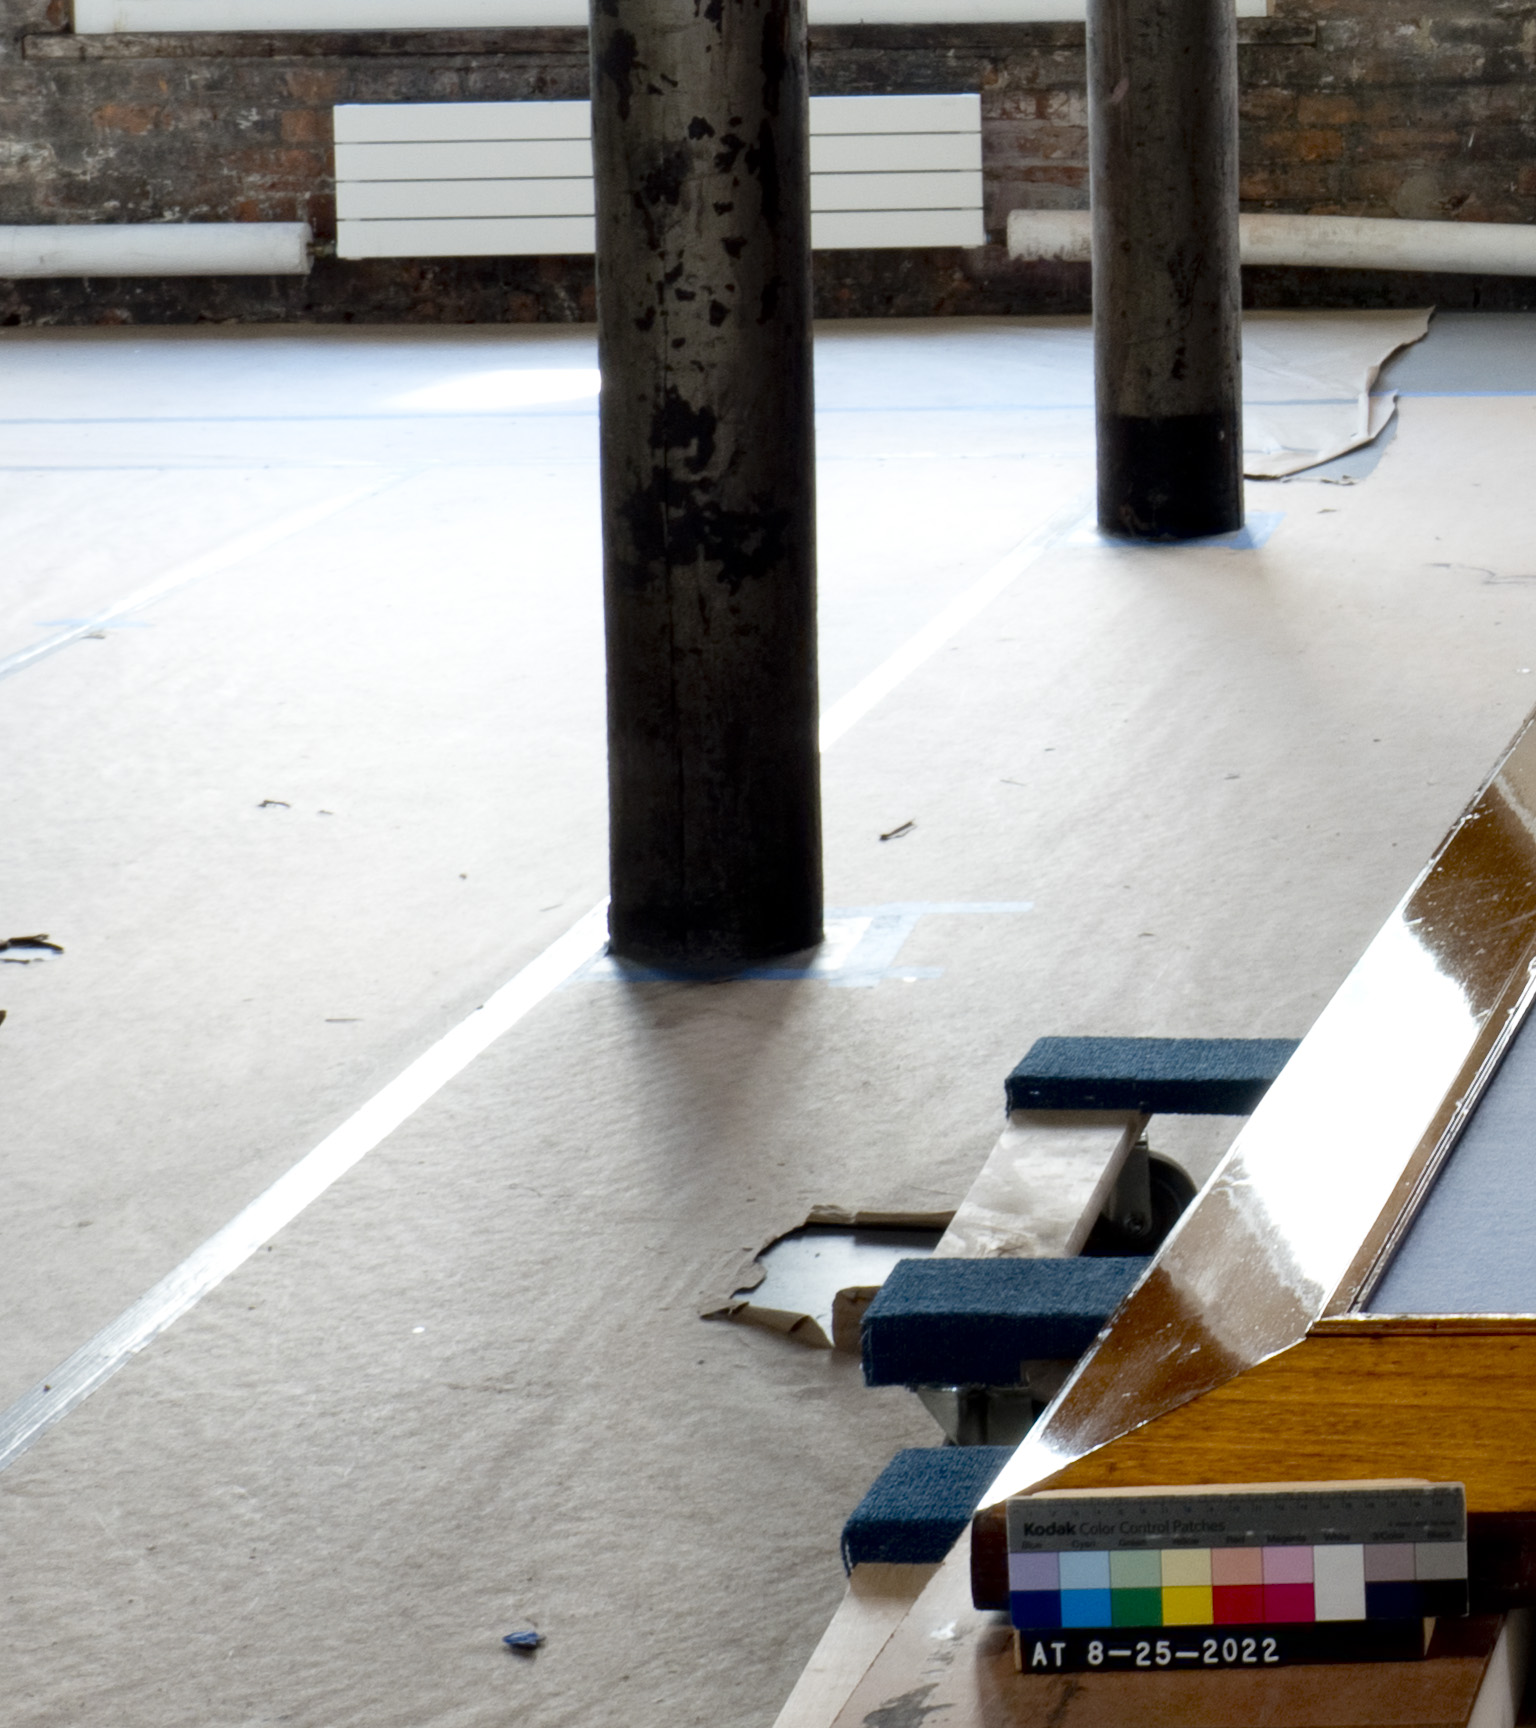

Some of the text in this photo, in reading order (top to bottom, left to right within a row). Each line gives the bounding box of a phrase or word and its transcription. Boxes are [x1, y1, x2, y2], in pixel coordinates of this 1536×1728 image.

[1023, 1519, 1226, 1536] Kodak Color Control Patches
[1032, 1637, 1279, 1667] AT 8-25-2022
